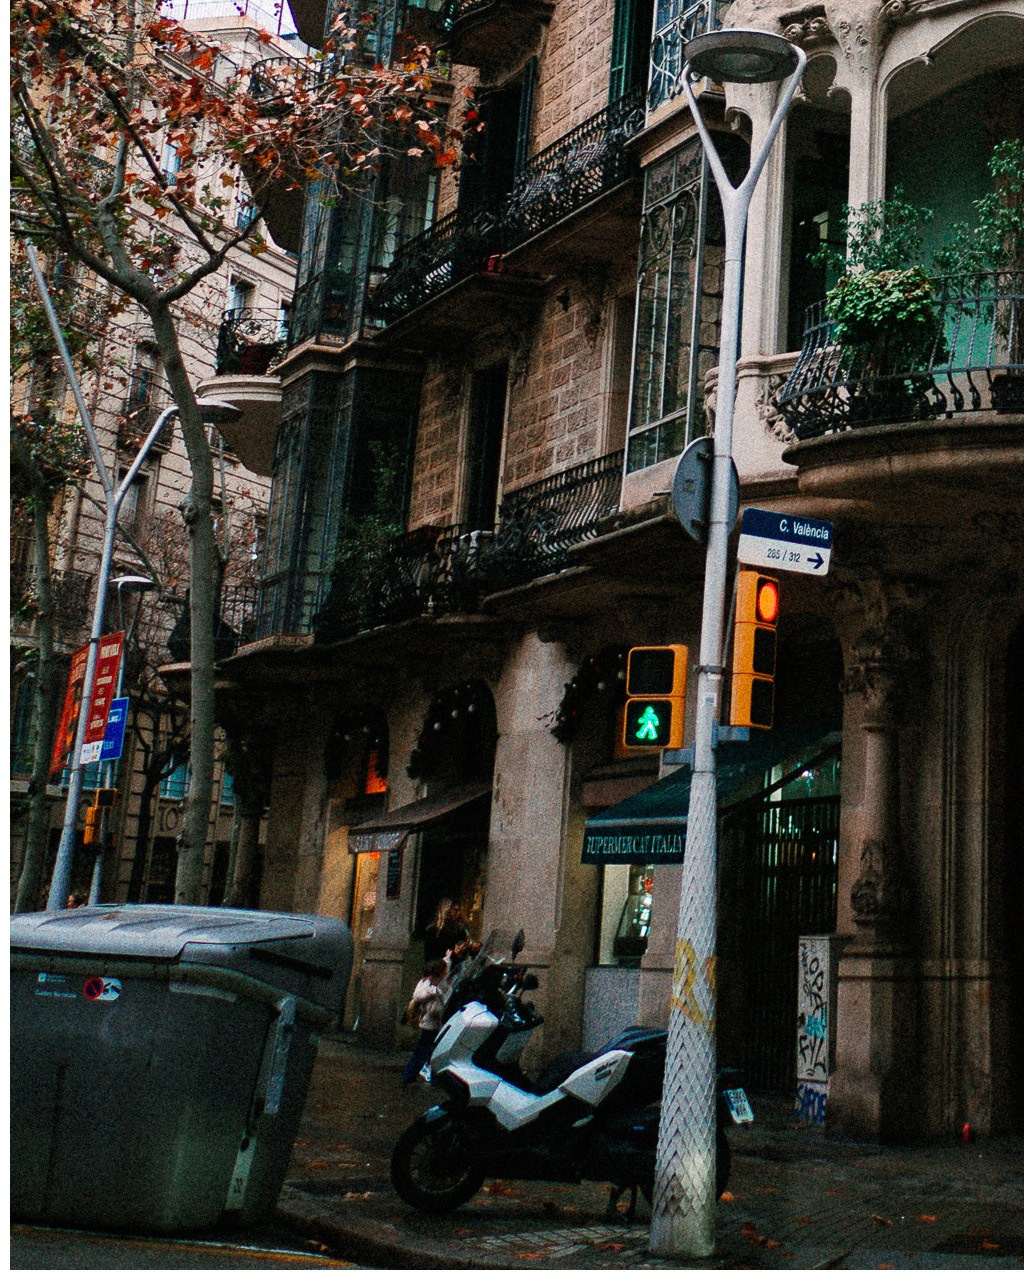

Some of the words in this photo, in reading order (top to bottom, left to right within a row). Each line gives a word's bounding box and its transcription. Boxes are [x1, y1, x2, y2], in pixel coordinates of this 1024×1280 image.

[779, 519, 789, 532] C.
[793, 521, 829, 540] València
[788, 551, 800, 563] 312
